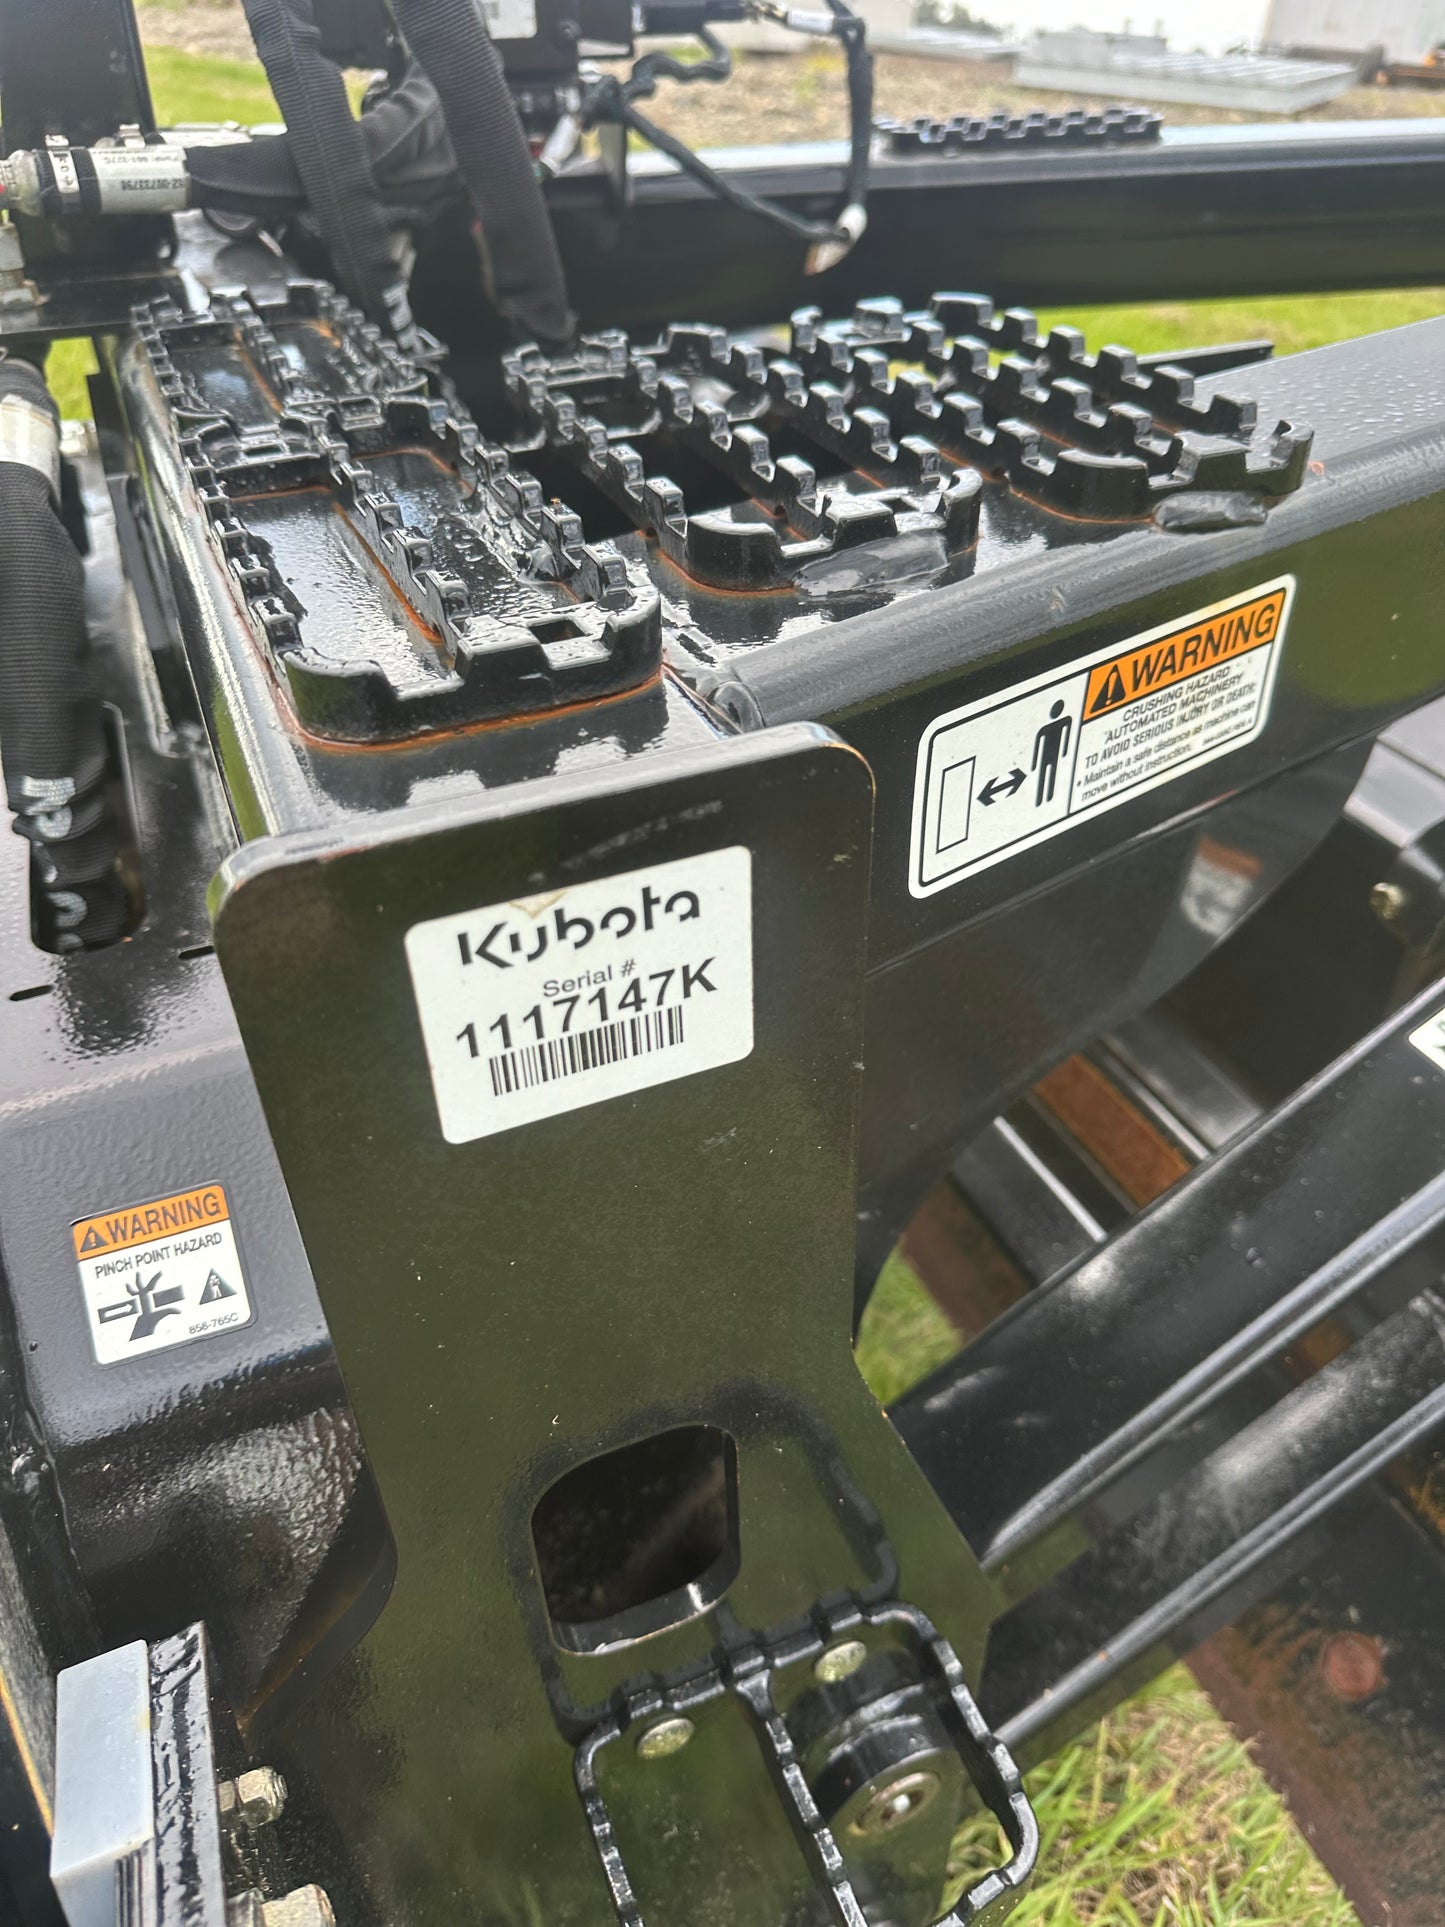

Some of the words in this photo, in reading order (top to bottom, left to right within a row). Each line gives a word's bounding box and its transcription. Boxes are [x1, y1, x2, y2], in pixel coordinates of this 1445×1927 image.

[1132, 603, 1275, 693] WARNING
[1105, 702, 1178, 744] AUTOMATED
[1180, 673, 1244, 710] MACHINERY
[1123, 685, 1183, 722] CRUSHING
[1185, 665, 1231, 695] HAZARD
[1084, 759, 1123, 786] Maintain
[1125, 757, 1132, 768] a
[1133, 745, 1152, 763] safe
[1154, 730, 1190, 754] distance
[1085, 754, 1100, 770] TO
[1101, 738, 1130, 762] AVOID
[1133, 719, 1174, 748] SERIOUS
[1176, 702, 1209, 727] INJURY
[1211, 693, 1227, 712] OR
[1081, 784, 1108, 801] move
[1109, 763, 1143, 788] without
[457, 886, 701, 970] Kubota
[542, 964, 613, 998] Serial
[621, 958, 637, 979] #
[456, 957, 718, 1059] 1117147K
[105, 1192, 221, 1244] WARNING
[95, 1257, 133, 1279] PINCH
[136, 1246, 171, 1267] POINT
[174, 1231, 222, 1257] HAZARD
[189, 1312, 239, 1335] 858-765C
